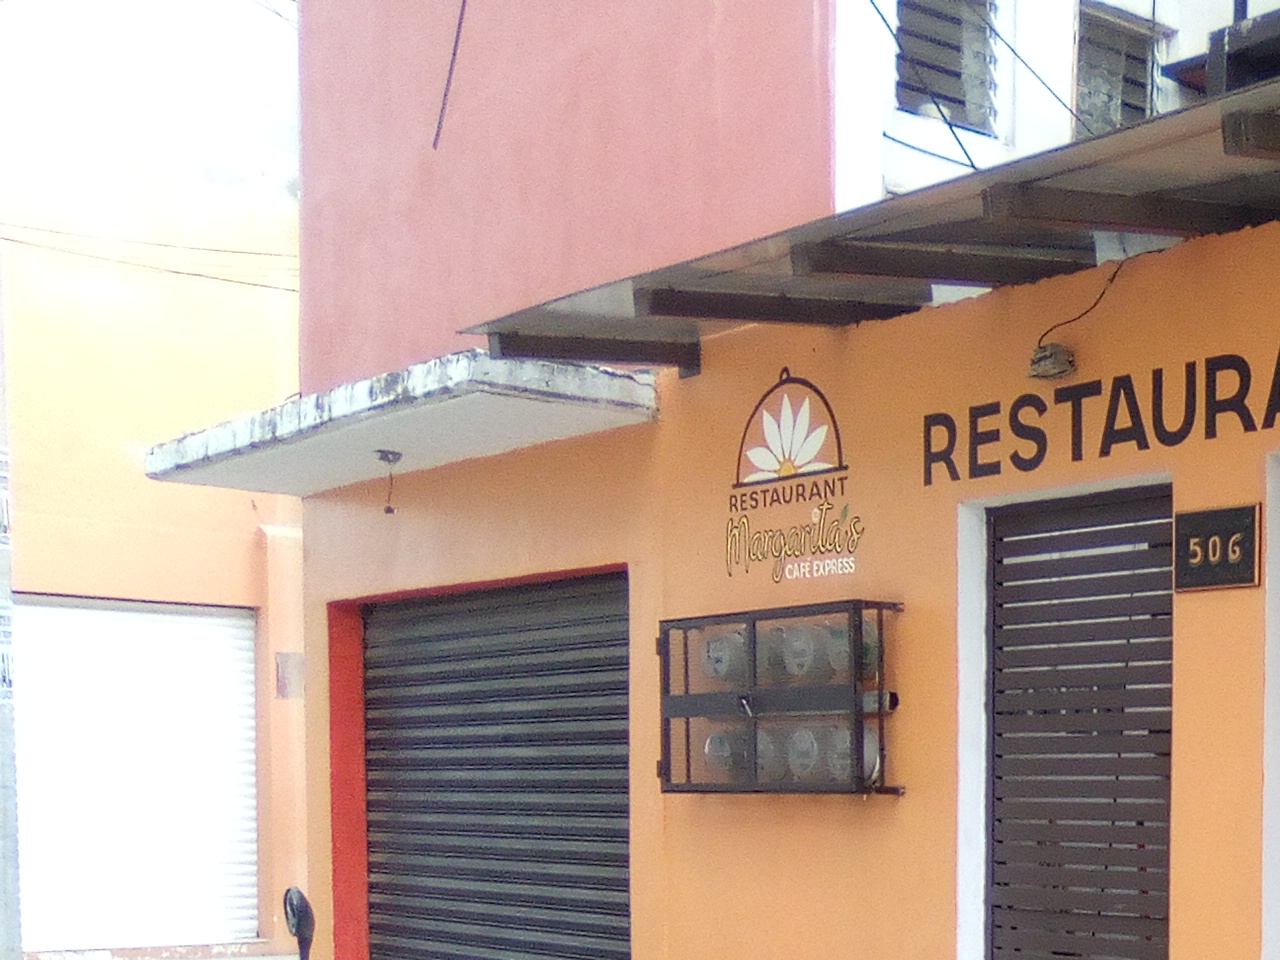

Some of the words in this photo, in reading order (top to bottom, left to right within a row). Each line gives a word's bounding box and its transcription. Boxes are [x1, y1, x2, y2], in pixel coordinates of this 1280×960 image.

[729, 476, 848, 513] RESTAURANT
[726, 500, 865, 584] Margarita's
[1188, 532, 1243, 566] 506
[785, 556, 811, 579] CAFÉ
[813, 557, 855, 577] EXPRESS
